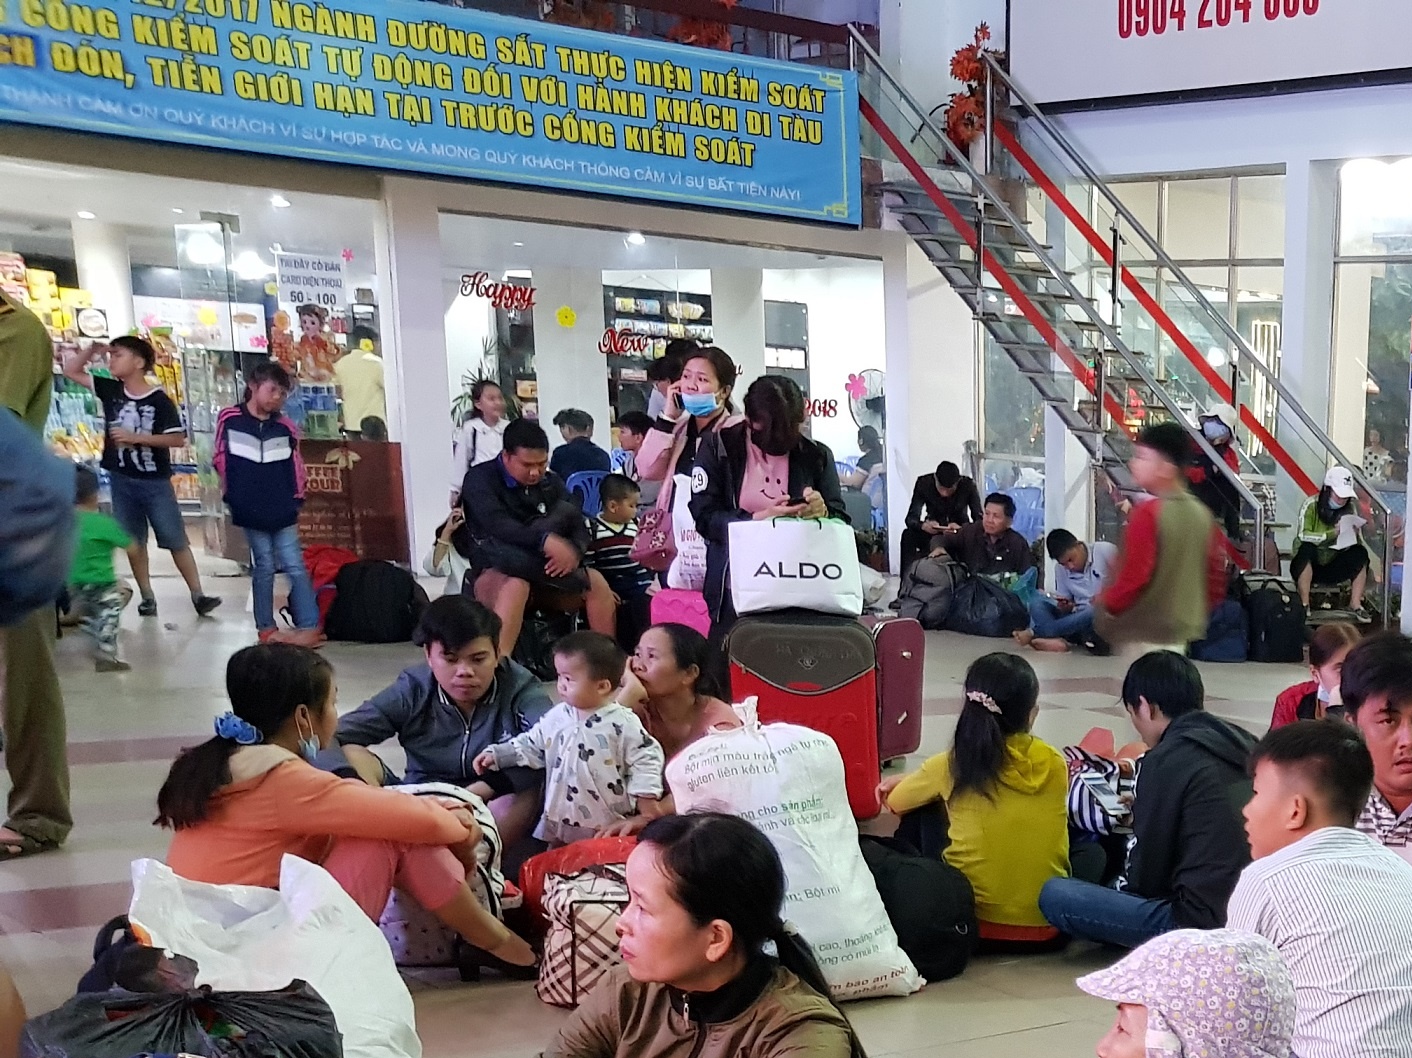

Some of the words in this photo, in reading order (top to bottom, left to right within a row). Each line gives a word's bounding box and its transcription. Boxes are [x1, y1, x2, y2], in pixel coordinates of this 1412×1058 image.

[270, 0, 378, 43] NGÀNH
[386, 18, 487, 60] ĐƯỜNG
[495, 32, 547, 69] SẮT
[555, 45, 627, 82] THỰC
[634, 58, 693, 94] HIỆN
[700, 67, 760, 103] KIỂM
[767, 81, 826, 114] SOÁT
[131, 12, 219, 56] KIỂM
[229, 30, 312, 70] SOÁT
[322, 45, 364, 82] TỰ
[372, 51, 453, 91] ĐỘNG
[462, 62, 512, 99] ĐỐI
[520, 74, 568, 108] VỚI
[576, 79, 647, 119] HÀNH
[655, 95, 738, 132] KHÁCH
[746, 109, 772, 137] ĐI
[778, 112, 823, 145] TÀU
[233, 69, 304, 107] GIỚI
[312, 81, 376, 118] HẠN
[383, 91, 432, 127] TẠI
[441, 99, 534, 137] TRƯỚC
[543, 108, 616, 148] CỔNG
[624, 122, 686, 158] KIỂM
[694, 135, 755, 168] SOÁT
[432, 144, 481, 160] MONG
[522, 152, 575, 172] KHÁCH
[578, 160, 630, 179] THÔNG
[290, 290, 304, 303] 50
[316, 292, 337, 305] 100
[460, 271, 537, 311] Happy
[598, 328, 649, 354] New
[805, 398, 838, 418] 2018
[753, 561, 842, 580] ALDO
[687, 771, 715, 792] gluten
[758, 804, 778, 817] cho
[804, 887, 825, 900] Bột
